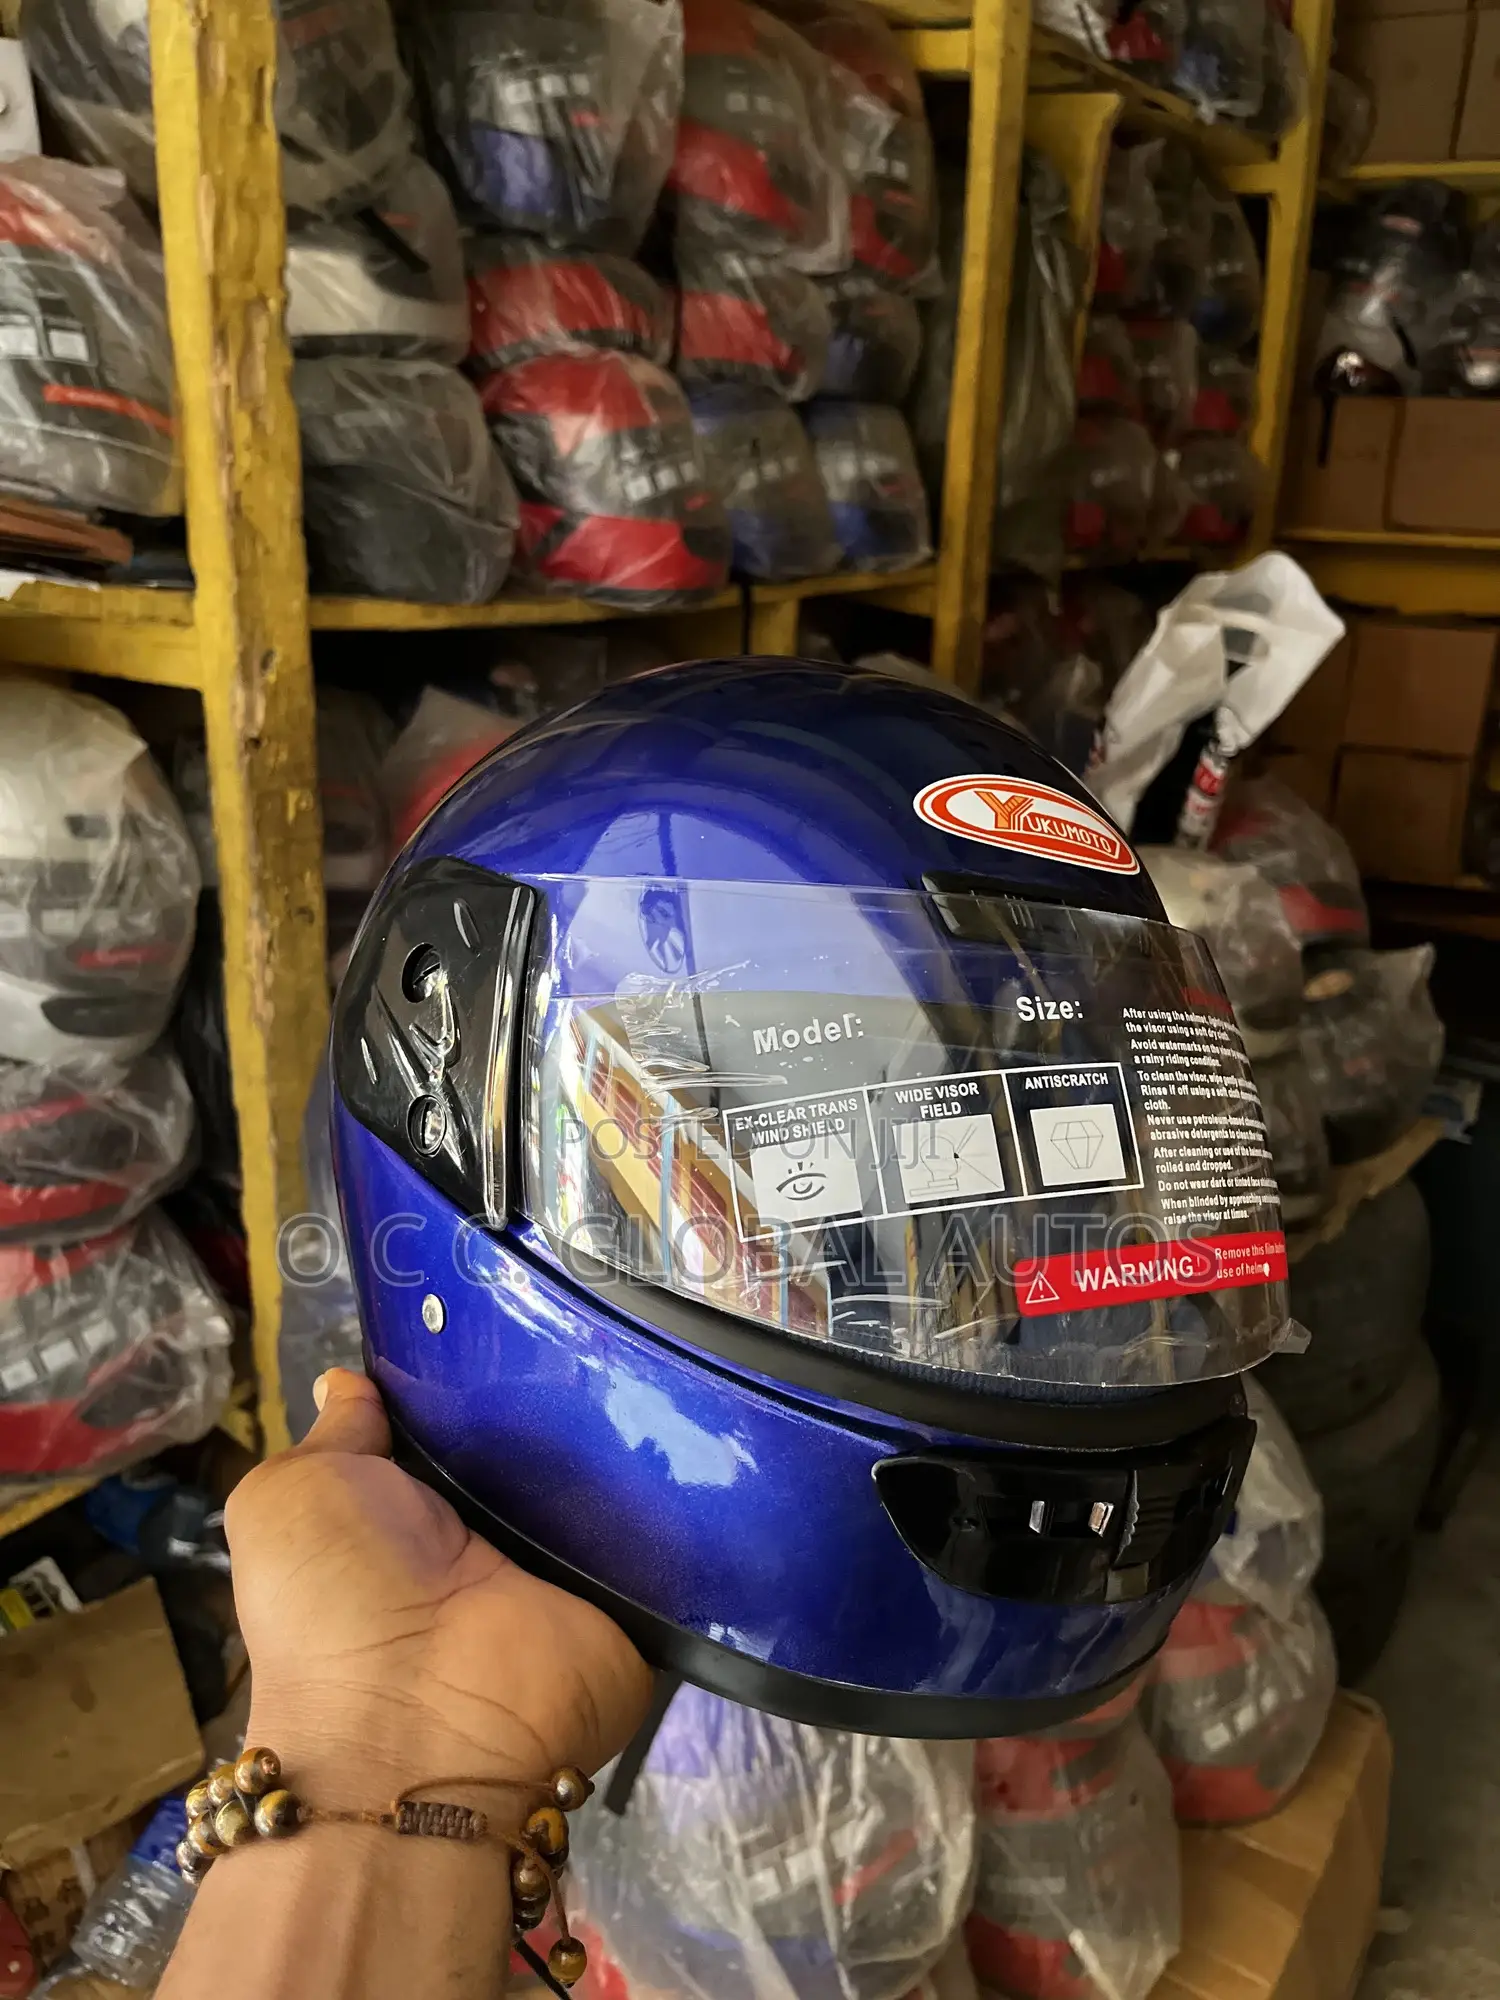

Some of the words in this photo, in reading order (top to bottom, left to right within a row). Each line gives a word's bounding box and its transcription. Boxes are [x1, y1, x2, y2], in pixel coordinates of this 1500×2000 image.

[974, 790, 1112, 855] YUKUMOTO
[1016, 995, 1084, 1022] Size:
[1123, 1008, 1146, 1018] After
[1148, 1009, 1172, 1022] using
[1172, 1010, 1185, 1021] the
[752, 1013, 864, 1055] Model:
[1126, 1022, 1142, 1032] the
[1143, 1022, 1166, 1033] visor
[1167, 1024, 1189, 1037] using
[1190, 1027, 1194, 1035] a
[1131, 1039, 1157, 1050] Avoid
[1158, 1040, 1201, 1052] watermarks
[1202, 1044, 1210, 1053] on
[1134, 1055, 1140, 1064] a
[1141, 1053, 1164, 1067] rainy
[1166, 1053, 1190, 1067] riding
[1025, 1073, 1109, 1090] ANTISCRATCH
[1137, 1070, 1150, 1082] To
[1150, 1070, 1175, 1081] clean
[1175, 1070, 1188, 1081] the
[1188, 1071, 1210, 1084] visor,
[895, 1087, 934, 1104] WIDE
[934, 1082, 980, 1100] VISOR
[1140, 1084, 1168, 1096] Rinse
[1177, 1084, 1189, 1096] off
[1190, 1085, 1211, 1099] using
[920, 1102, 962, 1119] FIELD
[1144, 1099, 1171, 1111] cloth.
[735, 1106, 807, 1131] EX-CLEAR
[808, 1098, 858, 1118] TRANS
[1147, 1114, 1175, 1126] Never
[1176, 1115, 1192, 1125] use
[752, 1127, 789, 1146] WIND
[793, 1118, 845, 1139] SHIELD
[1150, 1128, 1190, 1140] abrasive
[1191, 1128, 1229, 1141] detergents
[1154, 1147, 1177, 1158] After
[1179, 1146, 1214, 1158] cleaning
[1214, 1148, 1222, 1156] or
[1156, 1161, 1184, 1173] rolled
[1185, 1160, 1201, 1171] and
[1202, 1159, 1233, 1173] dropped.
[1158, 1180, 1172, 1192] Do
[1173, 1179, 1189, 1190] not
[1189, 1180, 1209, 1189] wear
[1210, 1176, 1227, 1188] dark
[1227, 1179, 1234, 1187] or
[1161, 1198, 1188, 1210] When
[1188, 1194, 1219, 1208] blinded
[1219, 1194, 1228, 1207] by
[1163, 1213, 1187, 1225] raise
[1188, 1211, 1202, 1223] the
[1202, 1210, 1222, 1221] visor
[1223, 1208, 1231, 1220] at
[1215, 1247, 1251, 1260] Remove
[1251, 1244, 1265, 1256] this
[1075, 1256, 1194, 1293] WARNING
[1217, 1266, 1234, 1279] use
[1236, 1262, 1244, 1276] of
[1245, 1261, 1270, 1278] helm
